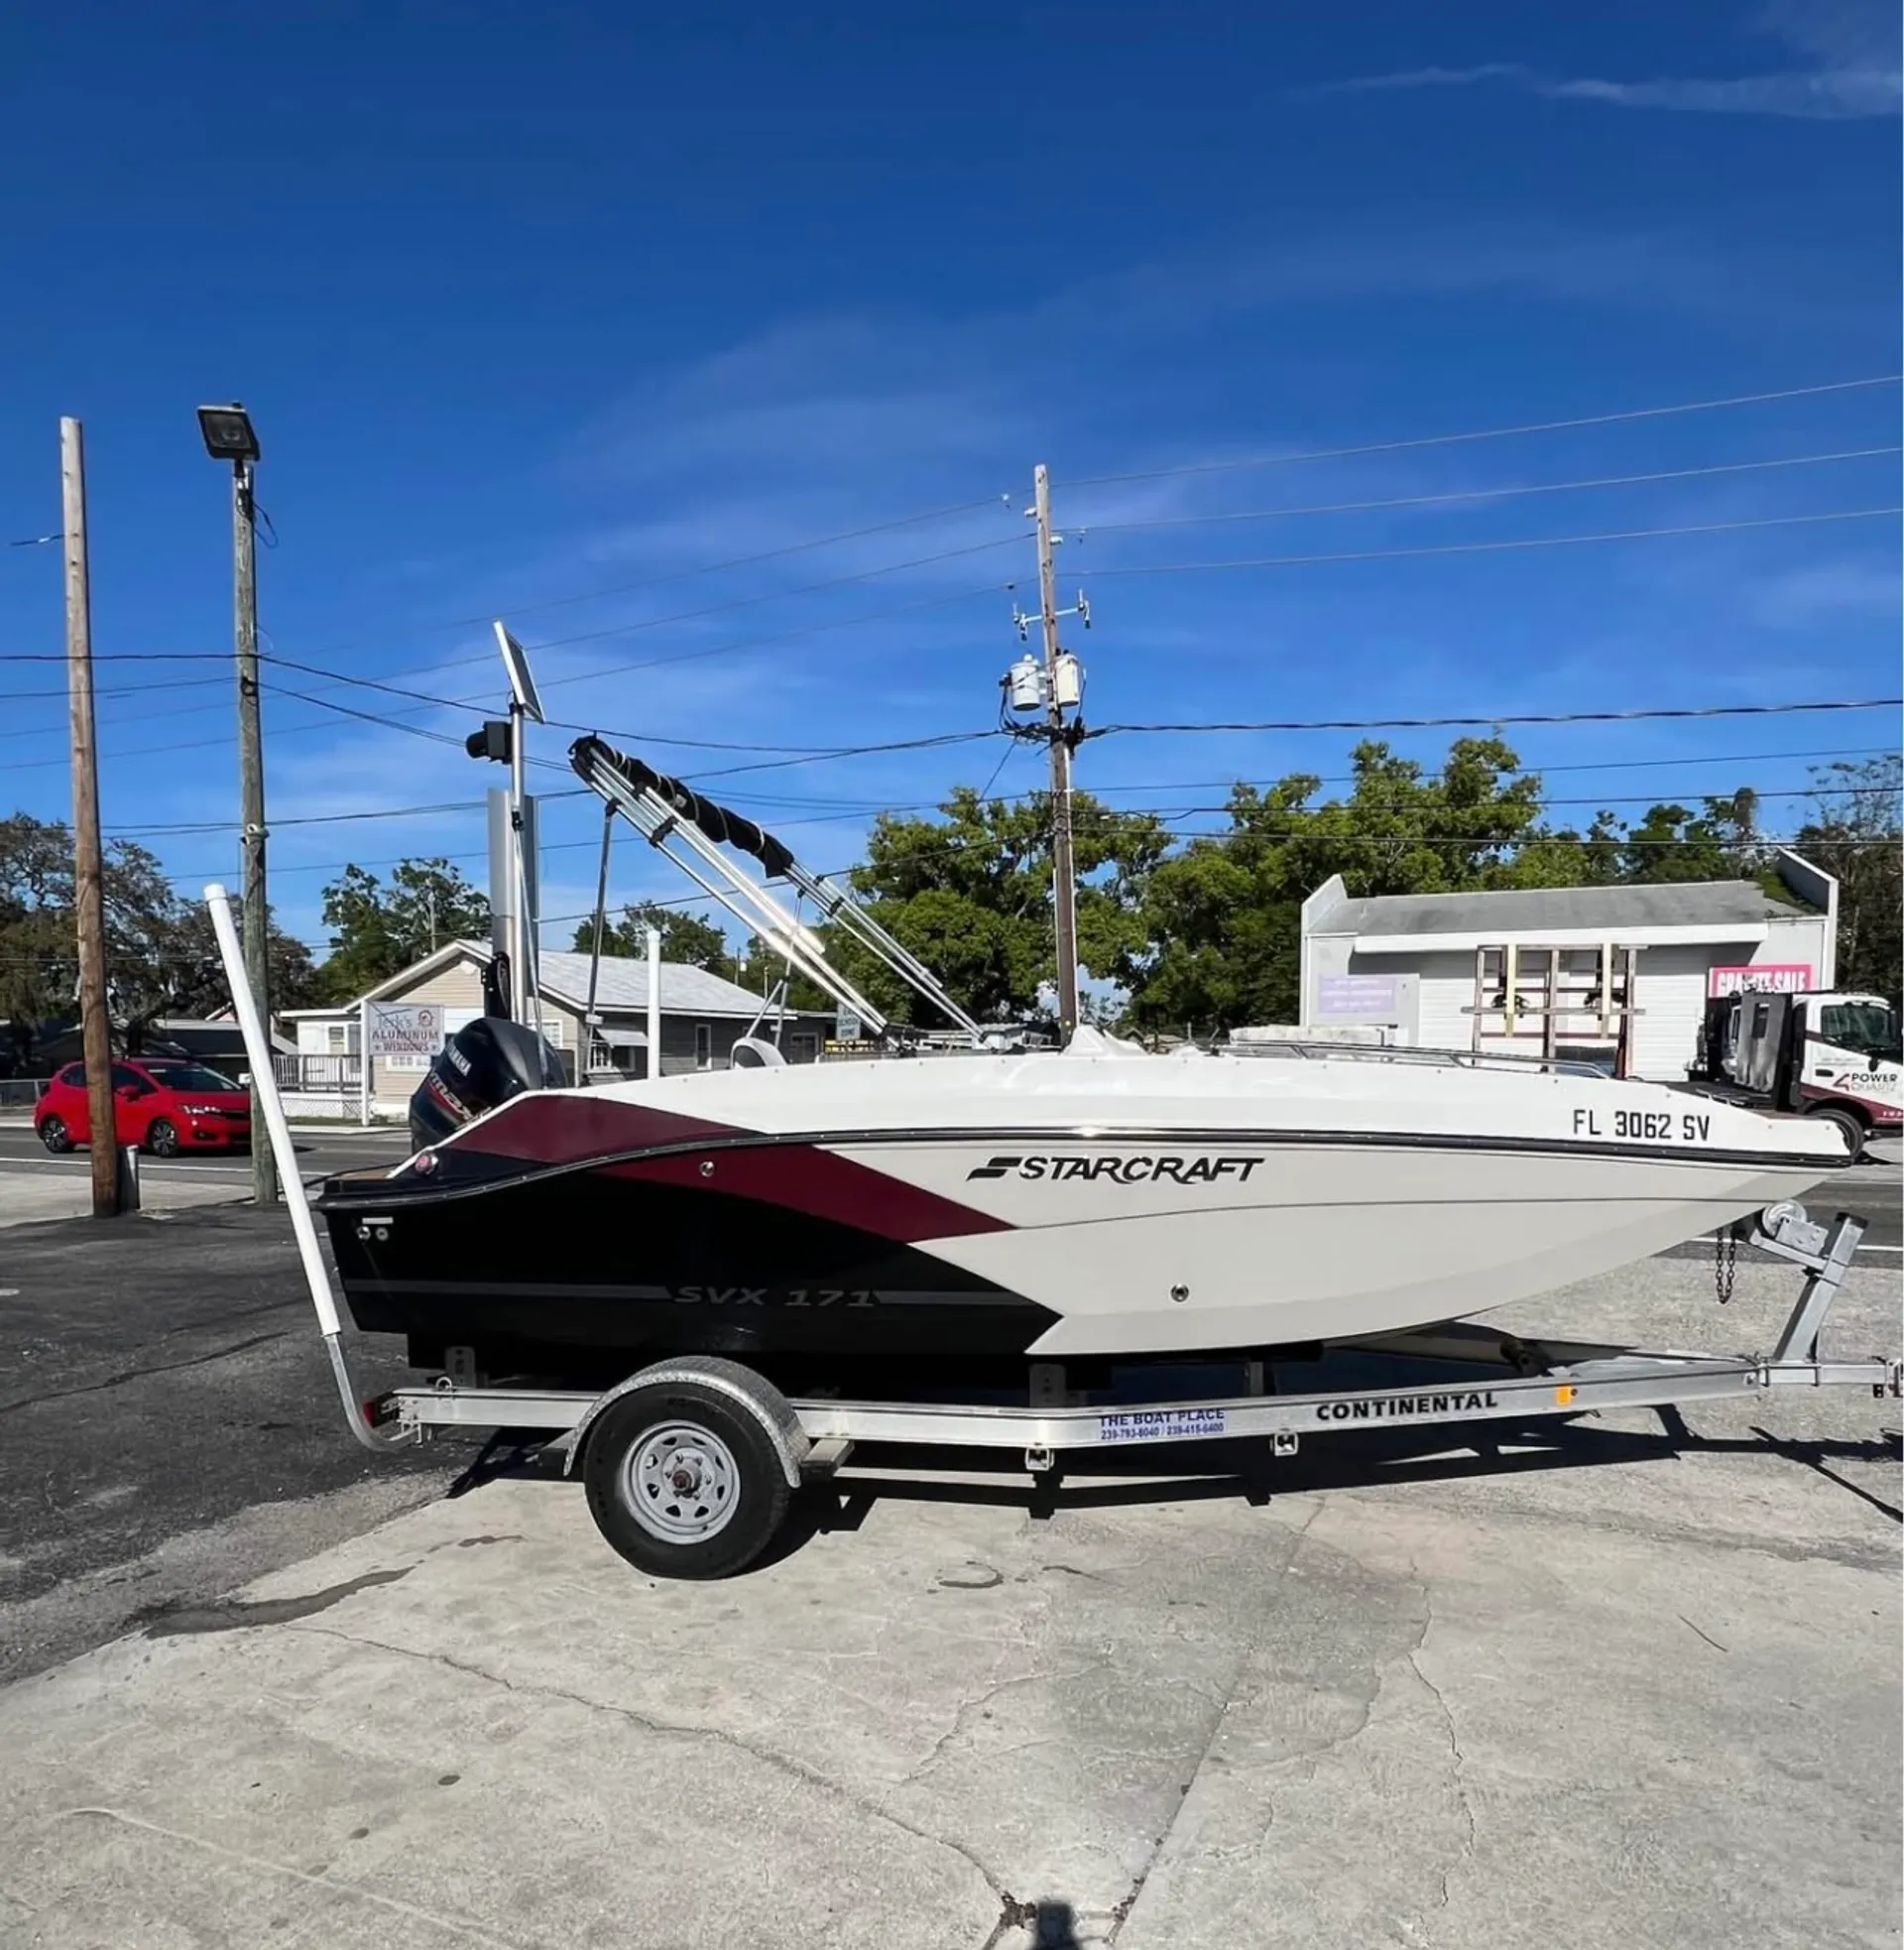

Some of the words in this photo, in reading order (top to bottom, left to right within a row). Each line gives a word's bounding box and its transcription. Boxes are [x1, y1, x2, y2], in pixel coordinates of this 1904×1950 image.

[372, 1031, 439, 1039] ALUMINUM
[445, 1037, 473, 1077] YAMAHA
[1851, 1073, 1898, 1082] POWER
[1573, 1109, 1602, 1136] FL
[1614, 1110, 1672, 1139] 3062
[1683, 1114, 1710, 1141] SV
[1018, 1157, 1265, 1184] STARCRAFT
[673, 1286, 769, 1305] SVX
[783, 1289, 875, 1307] 171
[1100, 1414, 1129, 1426] THE
[1133, 1411, 1173, 1425] BOAT
[1177, 1408, 1225, 1421] PLACE
[1316, 1393, 1498, 1420] CONTINENTAL
